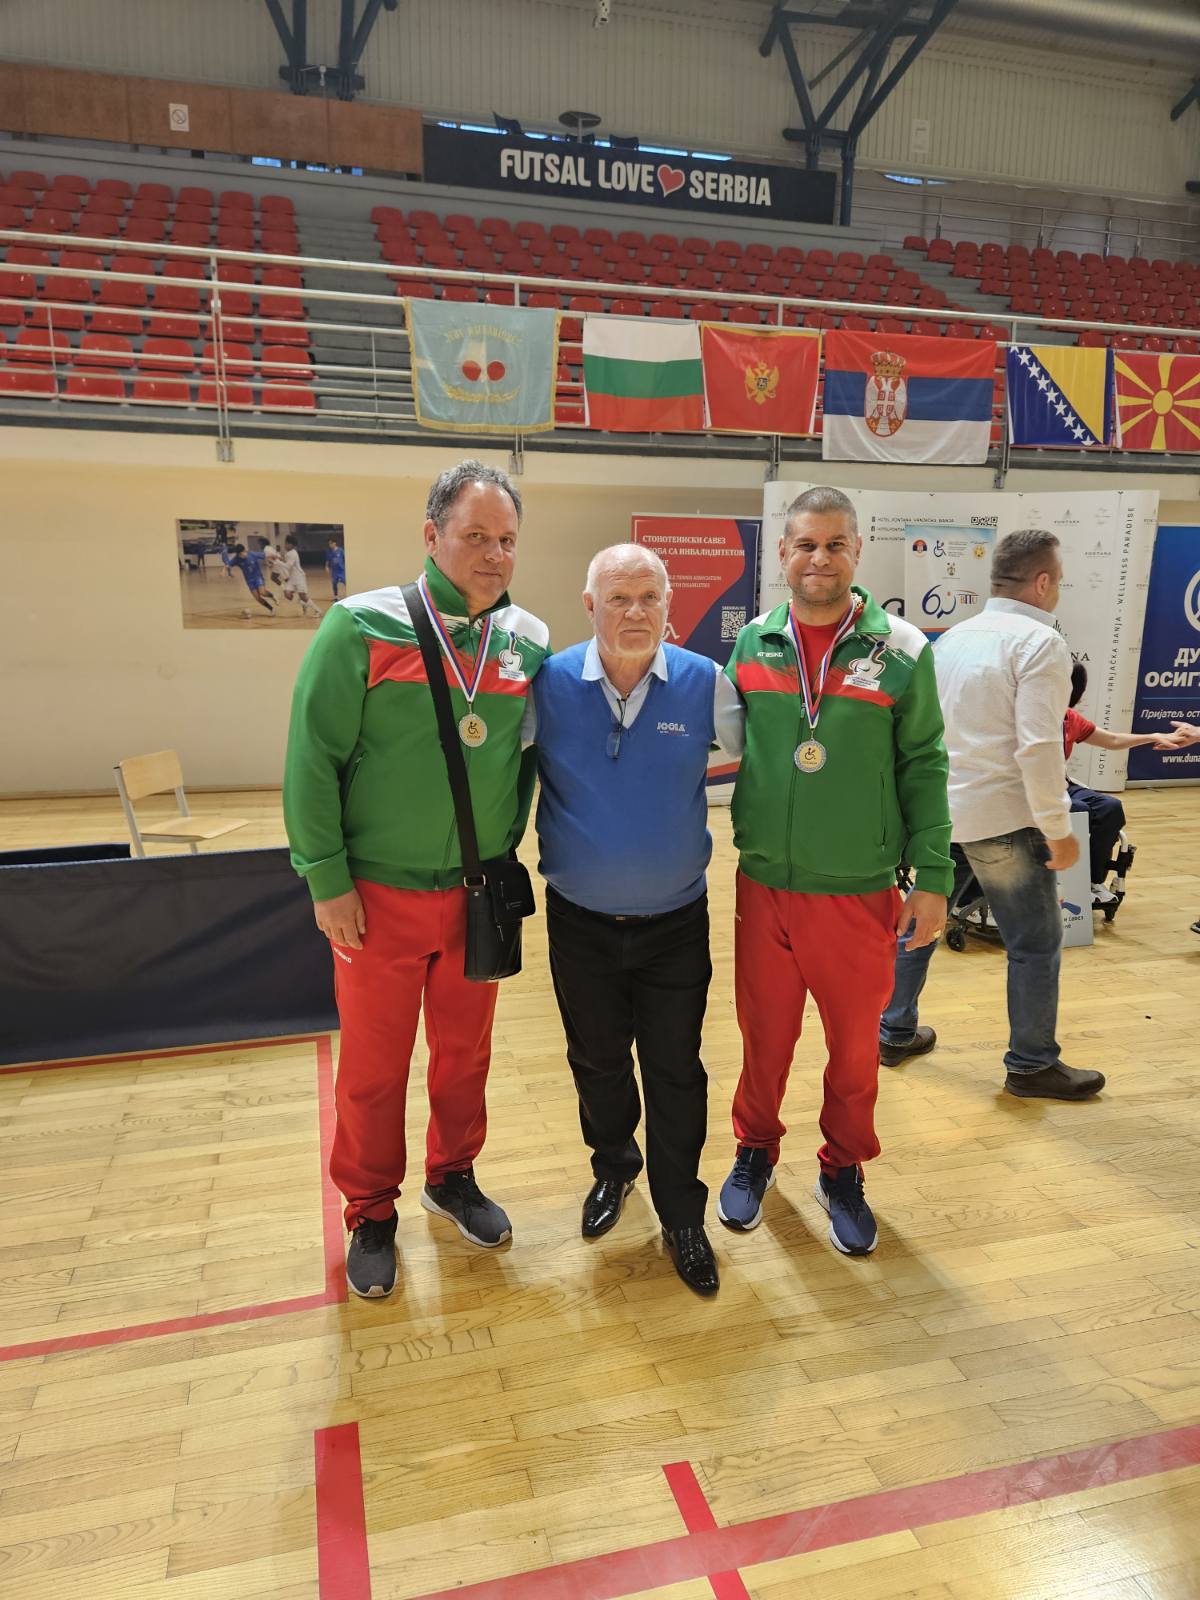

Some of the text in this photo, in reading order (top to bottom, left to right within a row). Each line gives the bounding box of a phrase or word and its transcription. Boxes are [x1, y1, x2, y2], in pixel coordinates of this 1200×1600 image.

[500, 149, 772, 206] FUTSAL LOVE SERBIA
[642, 535, 702, 544] СТОНОТЕНИСКИ
[1123, 507, 1135, 554] PARADISE
[648, 547, 667, 555] ОБА
[679, 548, 745, 557] ИНВАЛИДИТЕТОМ
[1117, 557, 1129, 605] WELLNESS
[1112, 616, 1123, 644] BANJA
[1107, 647, 1118, 692] VRNJAČKA
[1144, 671, 1200, 688] ОСИГ
[1140, 709, 1185, 719] Пријатељ
